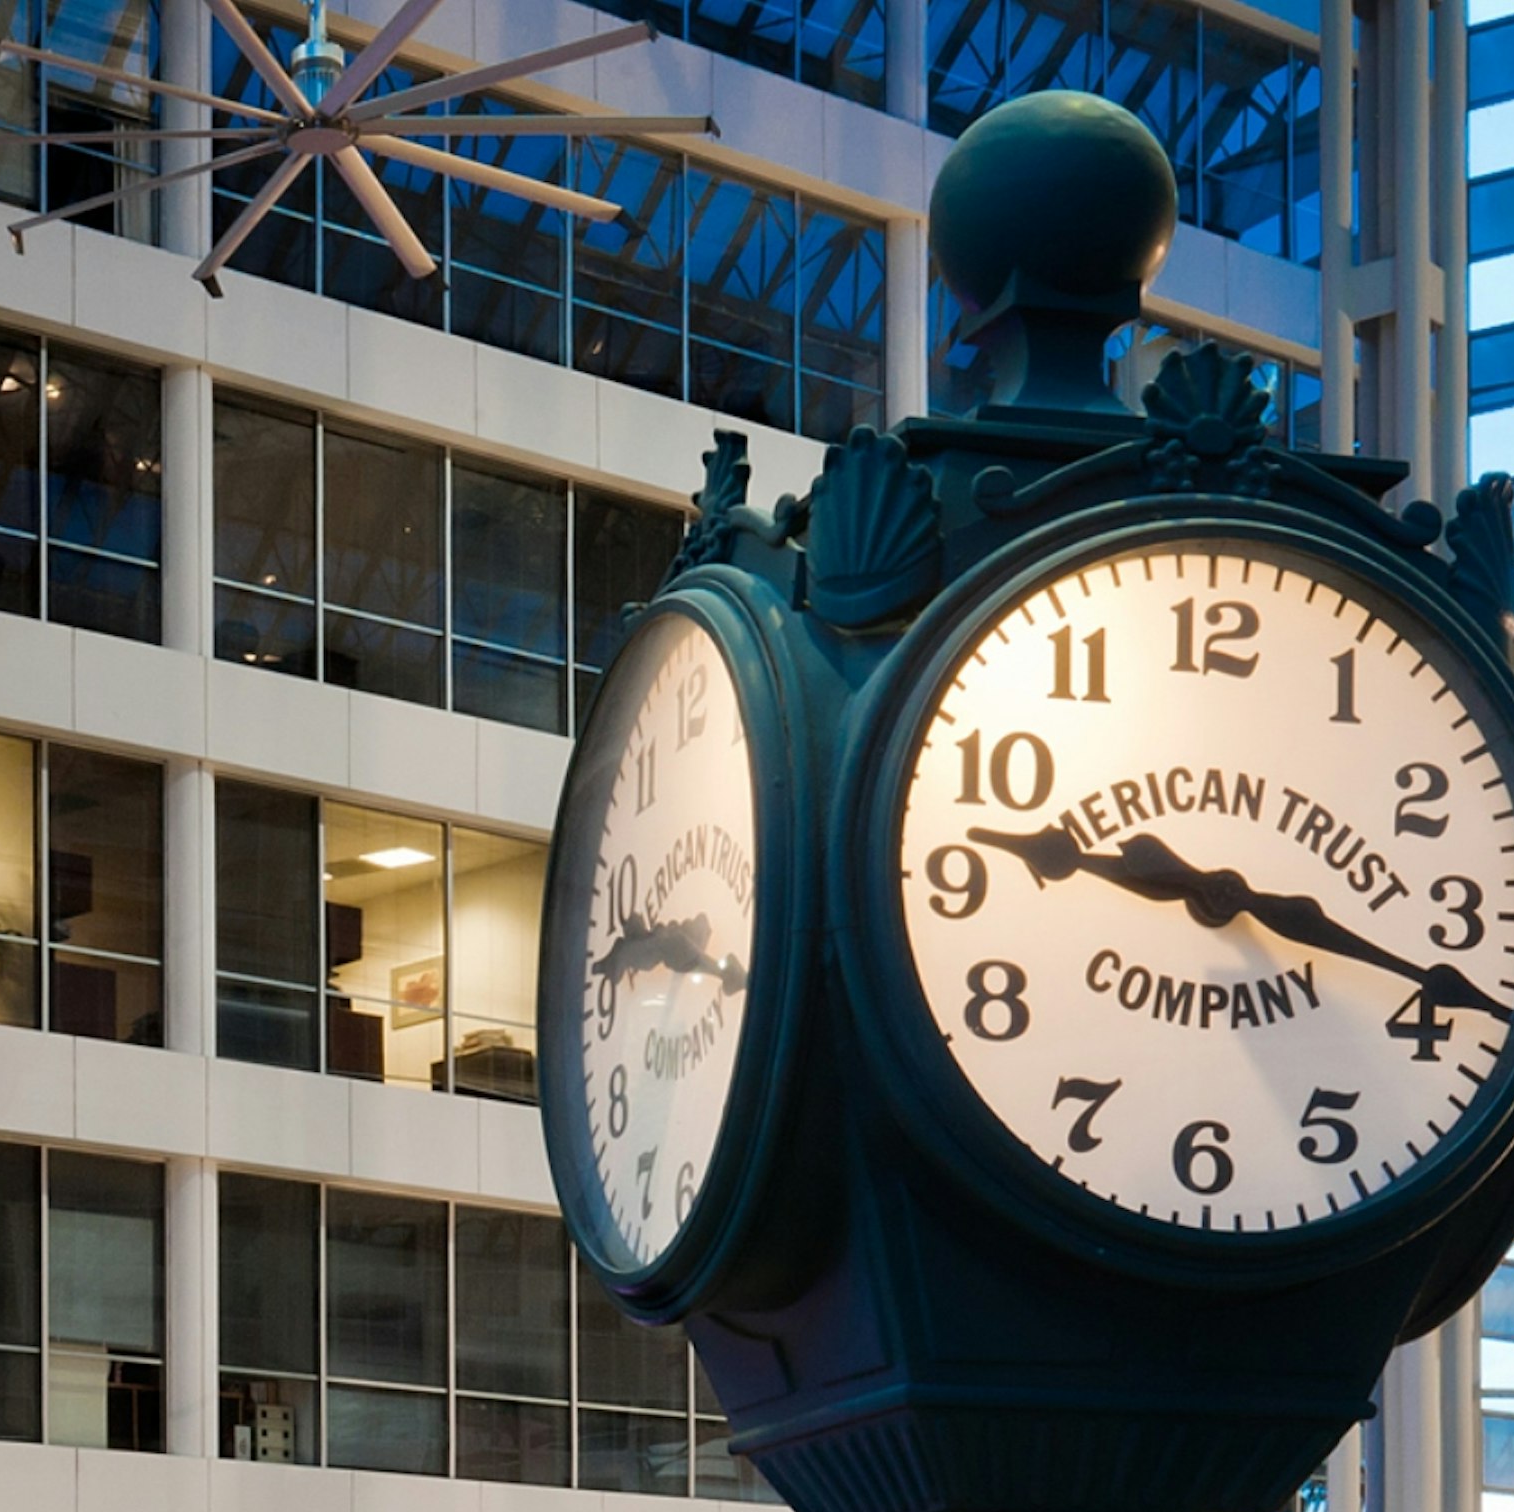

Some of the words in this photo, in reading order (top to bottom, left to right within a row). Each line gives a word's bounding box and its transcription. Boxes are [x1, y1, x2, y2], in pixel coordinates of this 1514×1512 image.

[1047, 625, 1112, 703] 11
[1169, 597, 1261, 679] 12
[675, 663, 708, 753] 12
[1329, 648, 1362, 724] 1
[635, 735, 656, 818] 11
[954, 729, 1055, 811] 10
[1394, 762, 1451, 839] 2
[925, 844, 988, 920] 9
[1273, 786, 1410, 913] TRUST
[607, 853, 637, 937] 10
[1428, 874, 1485, 951] 3
[597, 974, 616, 1041] 9
[963, 960, 1030, 1042] 8
[1086, 948, 1322, 1030] COMPANY
[1385, 984, 1454, 1063] 4
[644, 986, 724, 1081] COMPANY
[608, 1063, 629, 1140] 8
[1050, 1077, 1123, 1153] 7
[1297, 1087, 1361, 1165] 5
[637, 1145, 658, 1221] 7
[1171, 1120, 1235, 1195] 6
